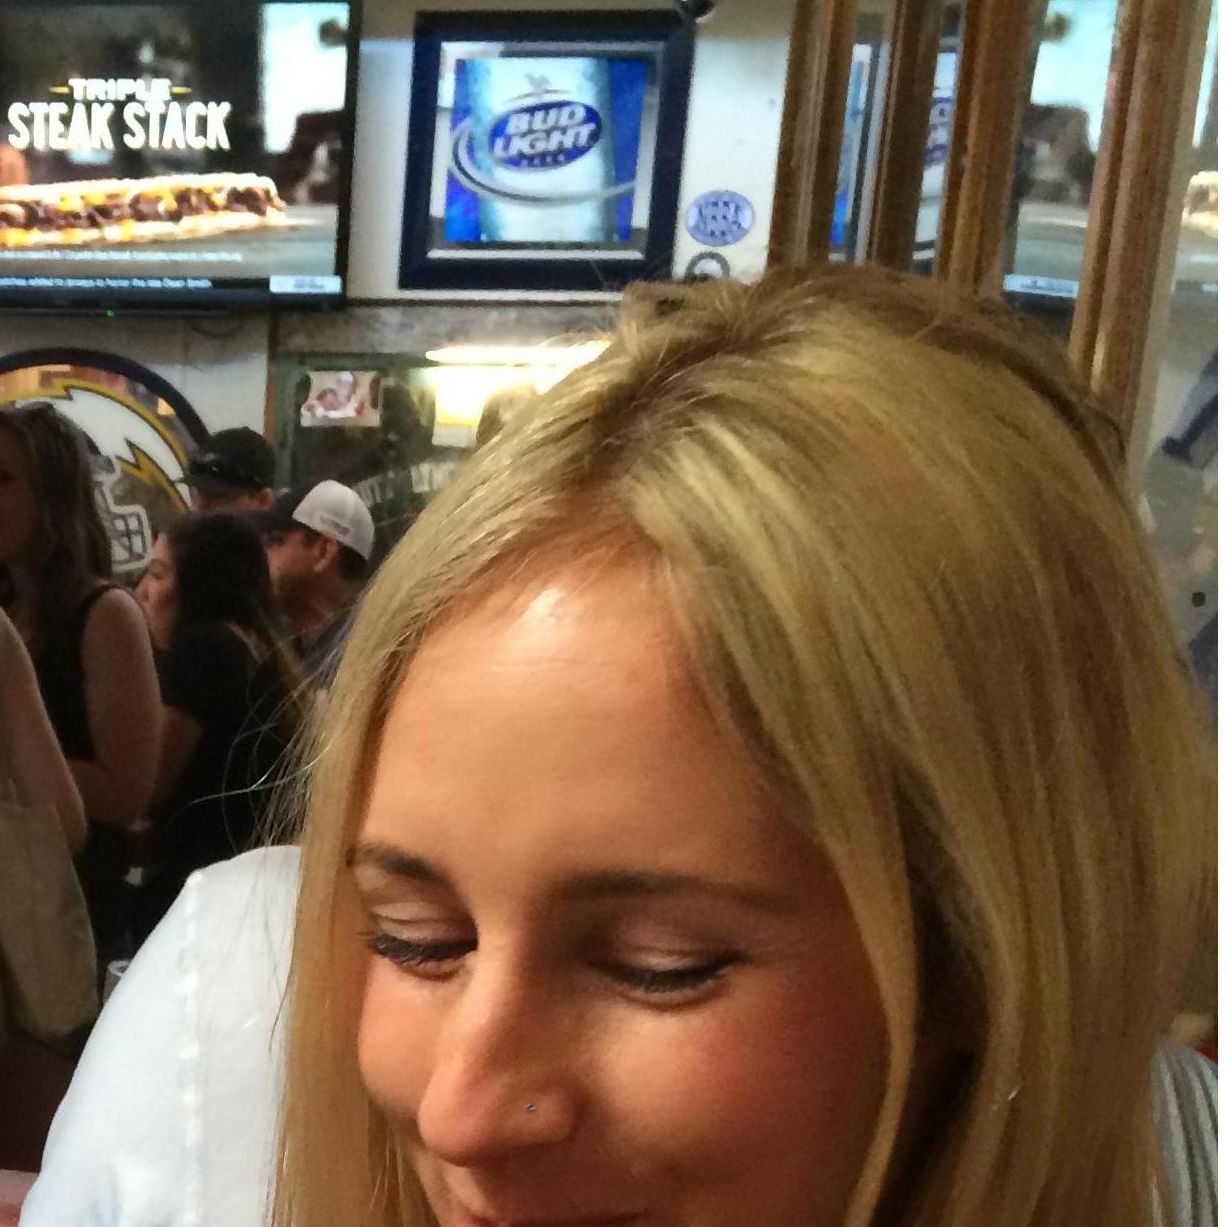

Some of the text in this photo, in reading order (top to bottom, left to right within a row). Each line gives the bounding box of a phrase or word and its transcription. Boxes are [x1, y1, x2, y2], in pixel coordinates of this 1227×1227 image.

[68, 78, 172, 101] TRIPLE
[7, 100, 231, 151] STEAK STACK
[506, 104, 587, 135] BUD
[493, 122, 596, 158] LIGHT
